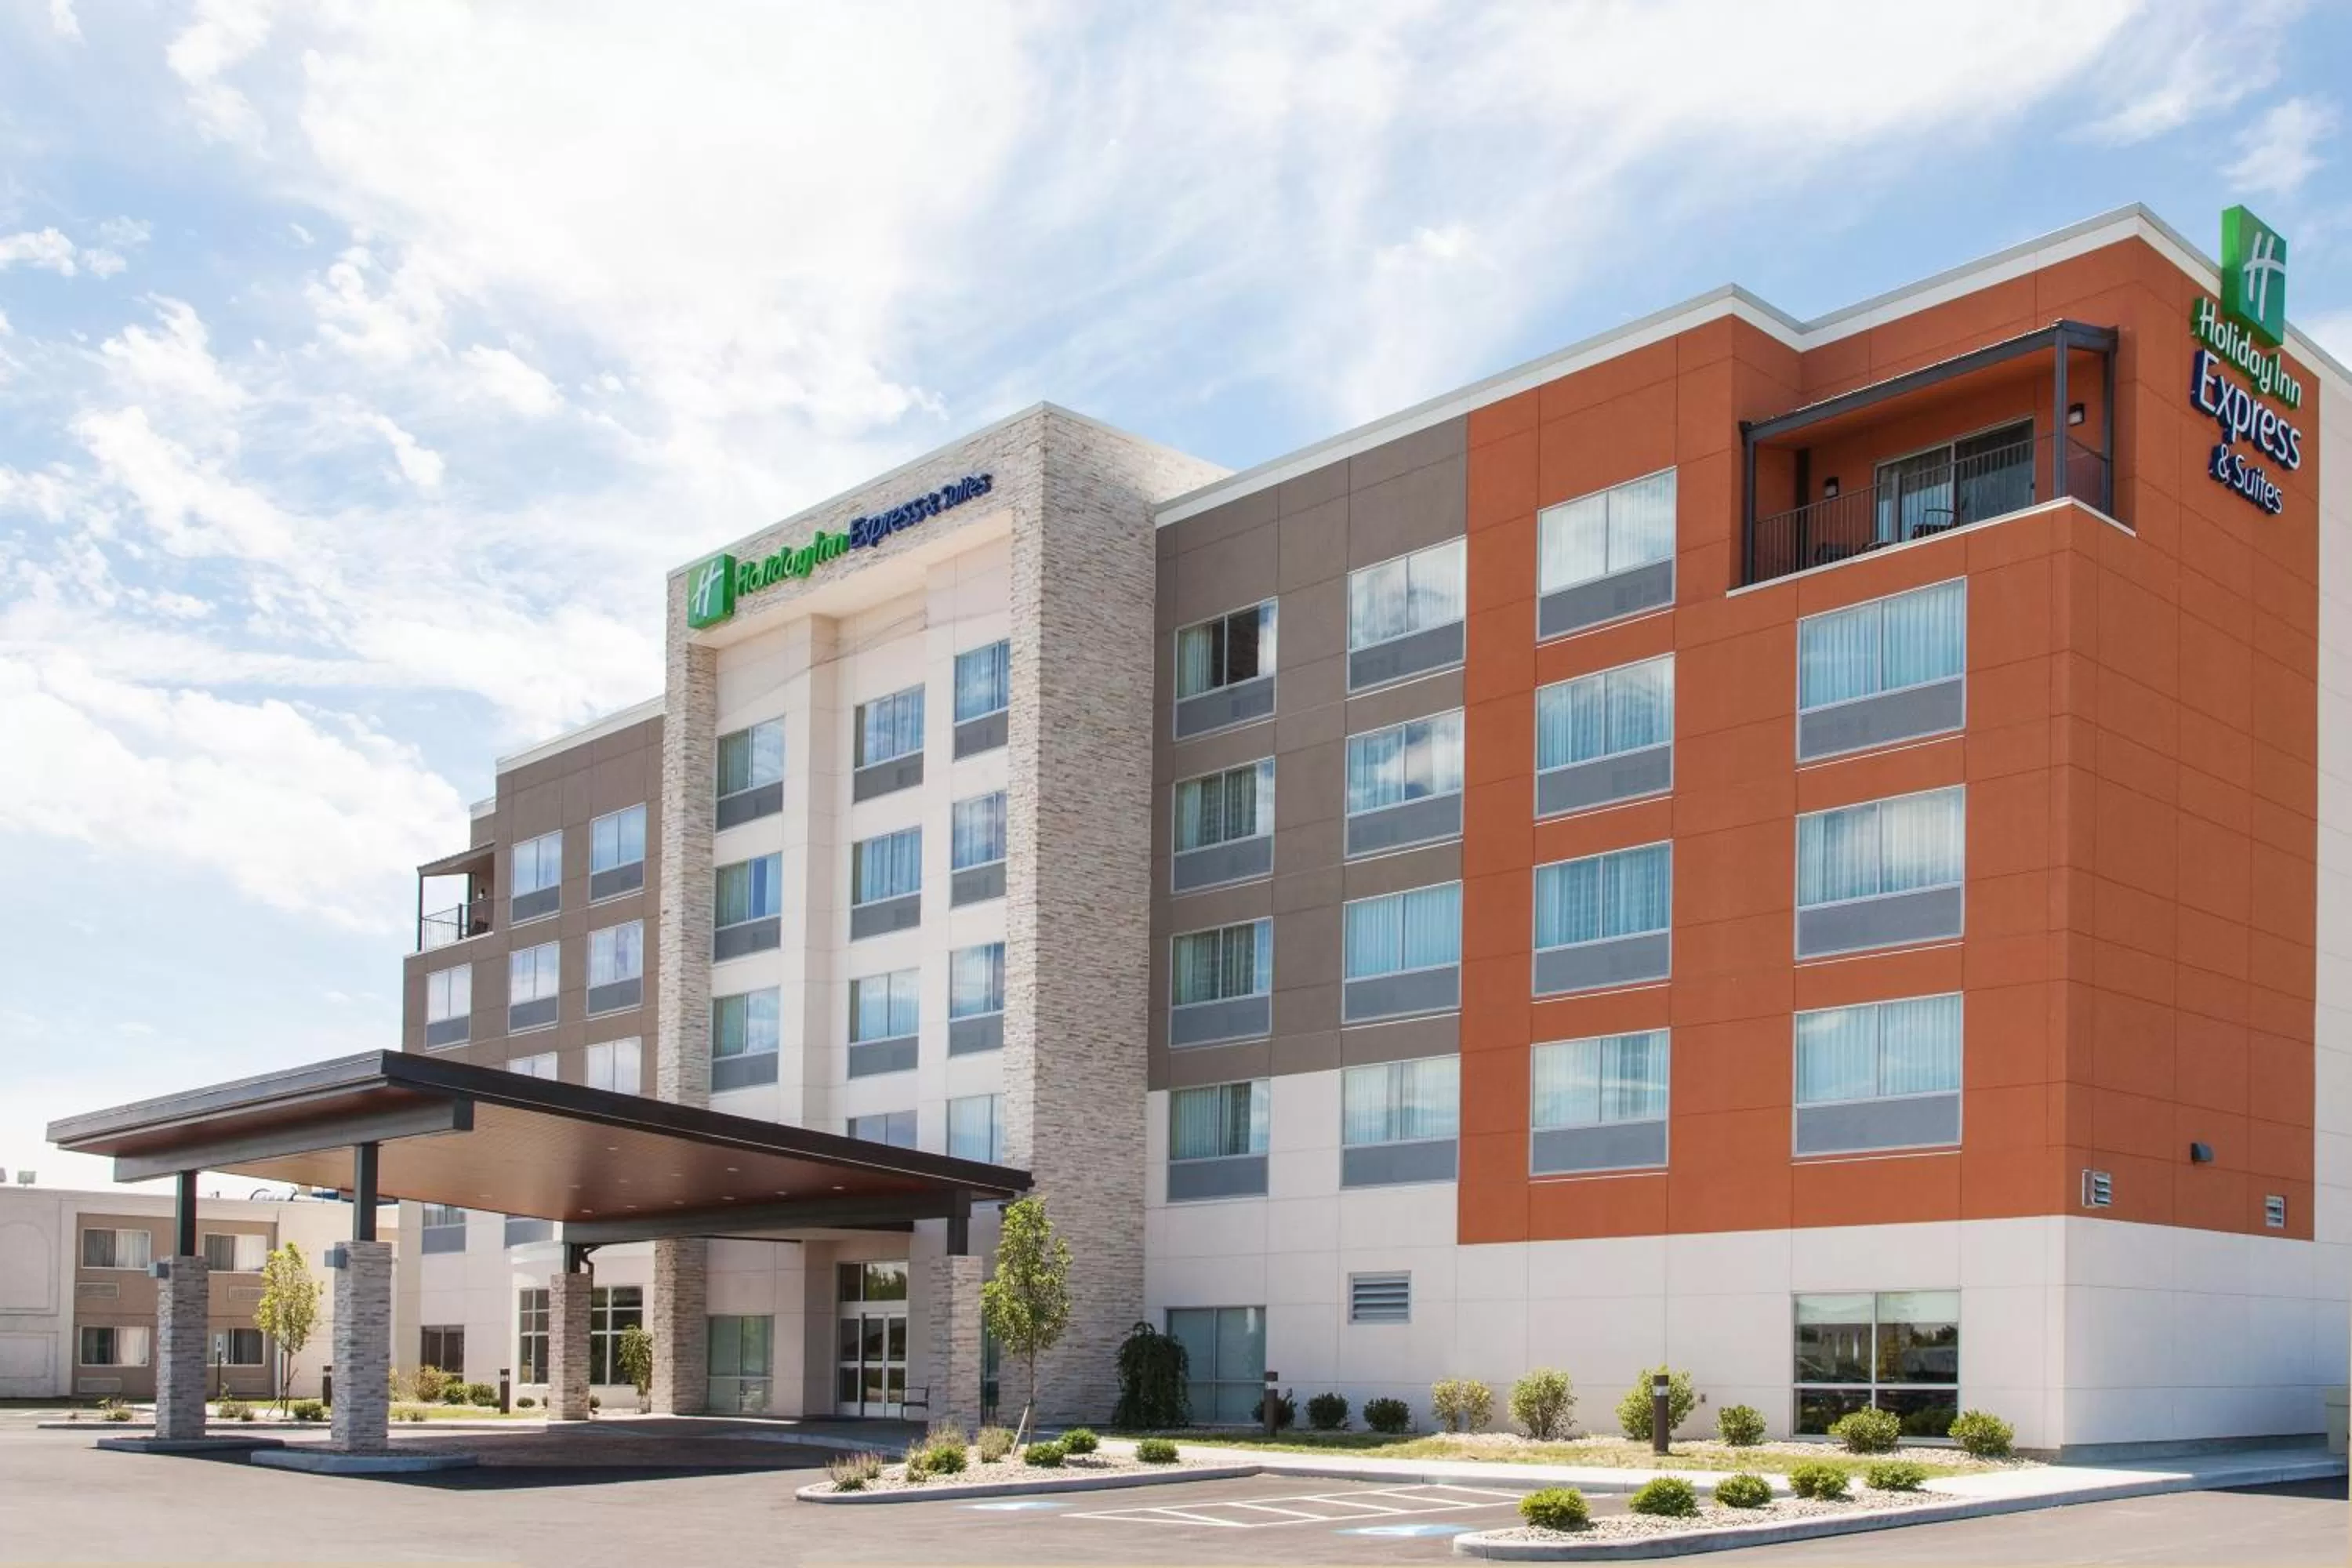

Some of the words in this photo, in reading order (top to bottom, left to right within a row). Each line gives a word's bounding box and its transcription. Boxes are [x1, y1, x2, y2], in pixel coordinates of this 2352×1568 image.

[2196, 349, 2302, 470] Express
[2198, 296, 2272, 394] Holiday
[2274, 354, 2302, 408] Inn
[735, 546, 814, 596] Holiday
[813, 531, 850, 564] Inn
[850, 498, 926, 548] Express
[926, 492, 941, 517] &
[940, 474, 993, 510] Suites
[2216, 443, 2231, 483] &
[2234, 454, 2283, 514] Suites
